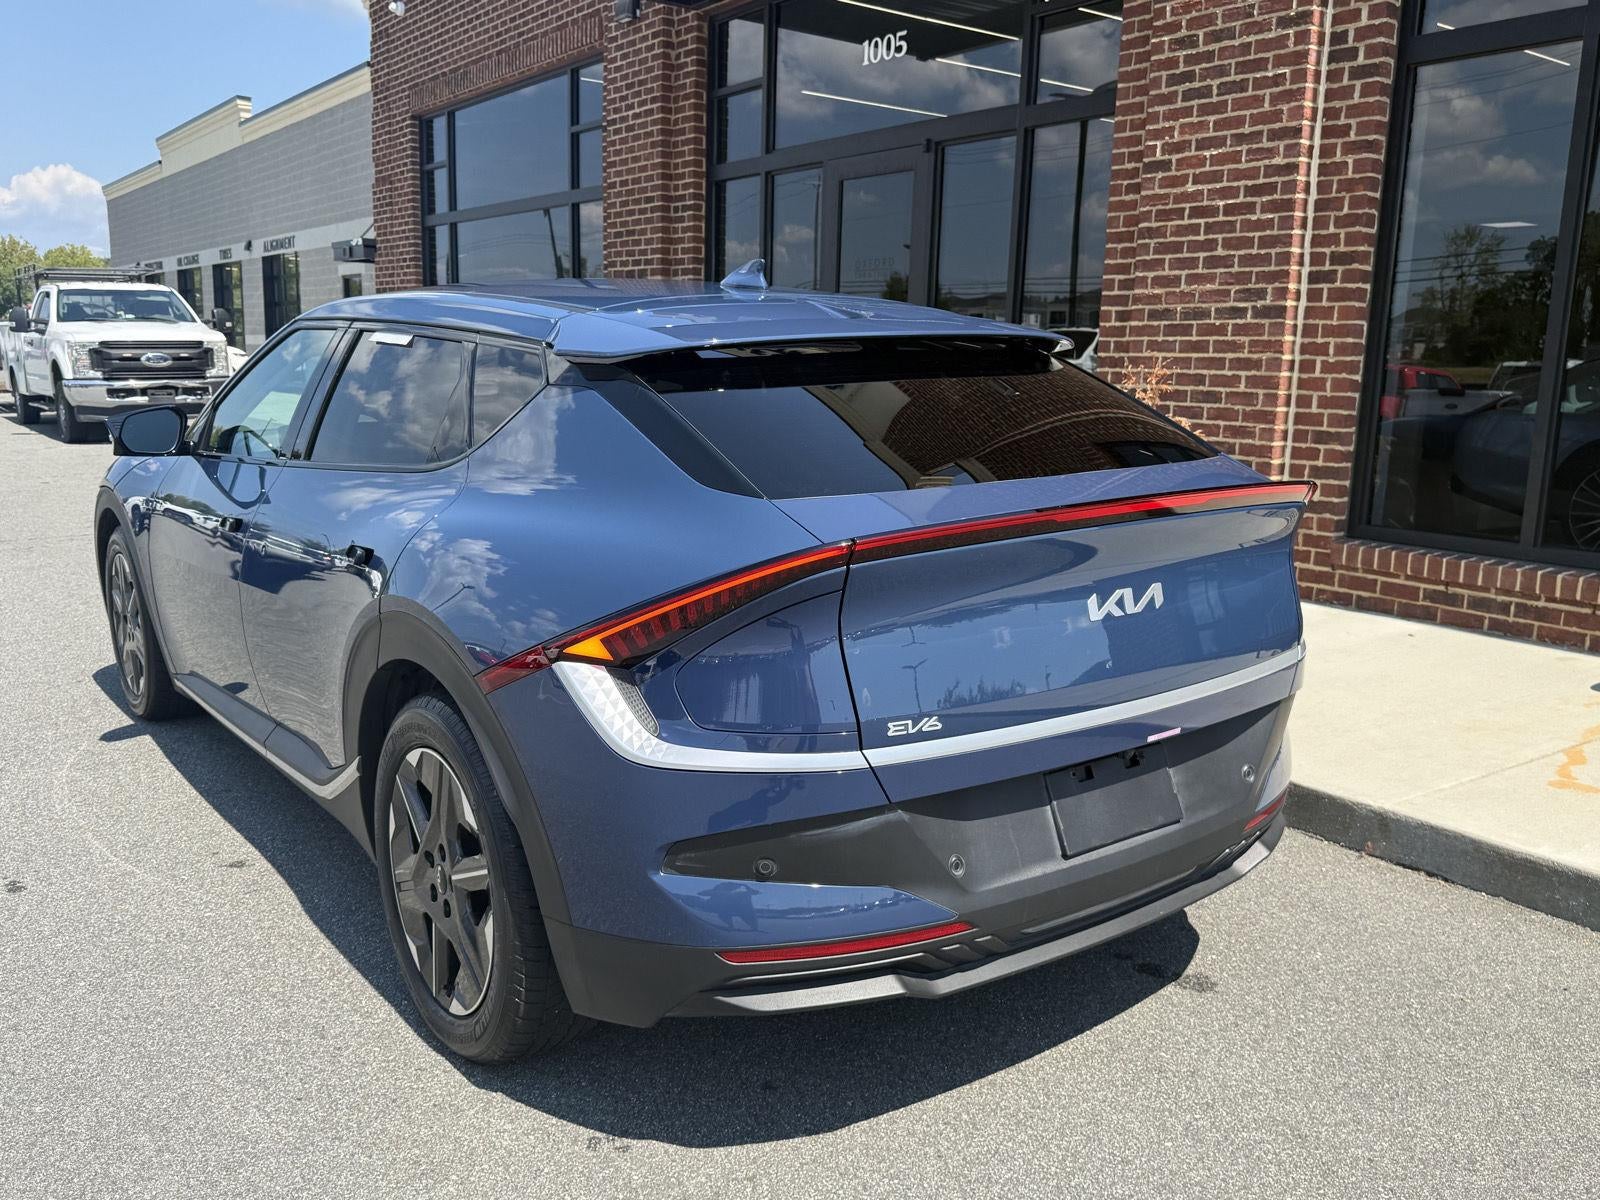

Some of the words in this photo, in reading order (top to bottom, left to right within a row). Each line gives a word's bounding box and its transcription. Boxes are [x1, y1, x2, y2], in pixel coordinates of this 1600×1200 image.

[862, 29, 908, 66] 1005
[219, 248, 232, 260] TIRES
[263, 235, 295, 252] ALIGNMENT
[1087, 582, 1164, 621] KIA
[887, 715, 942, 736] EV6
